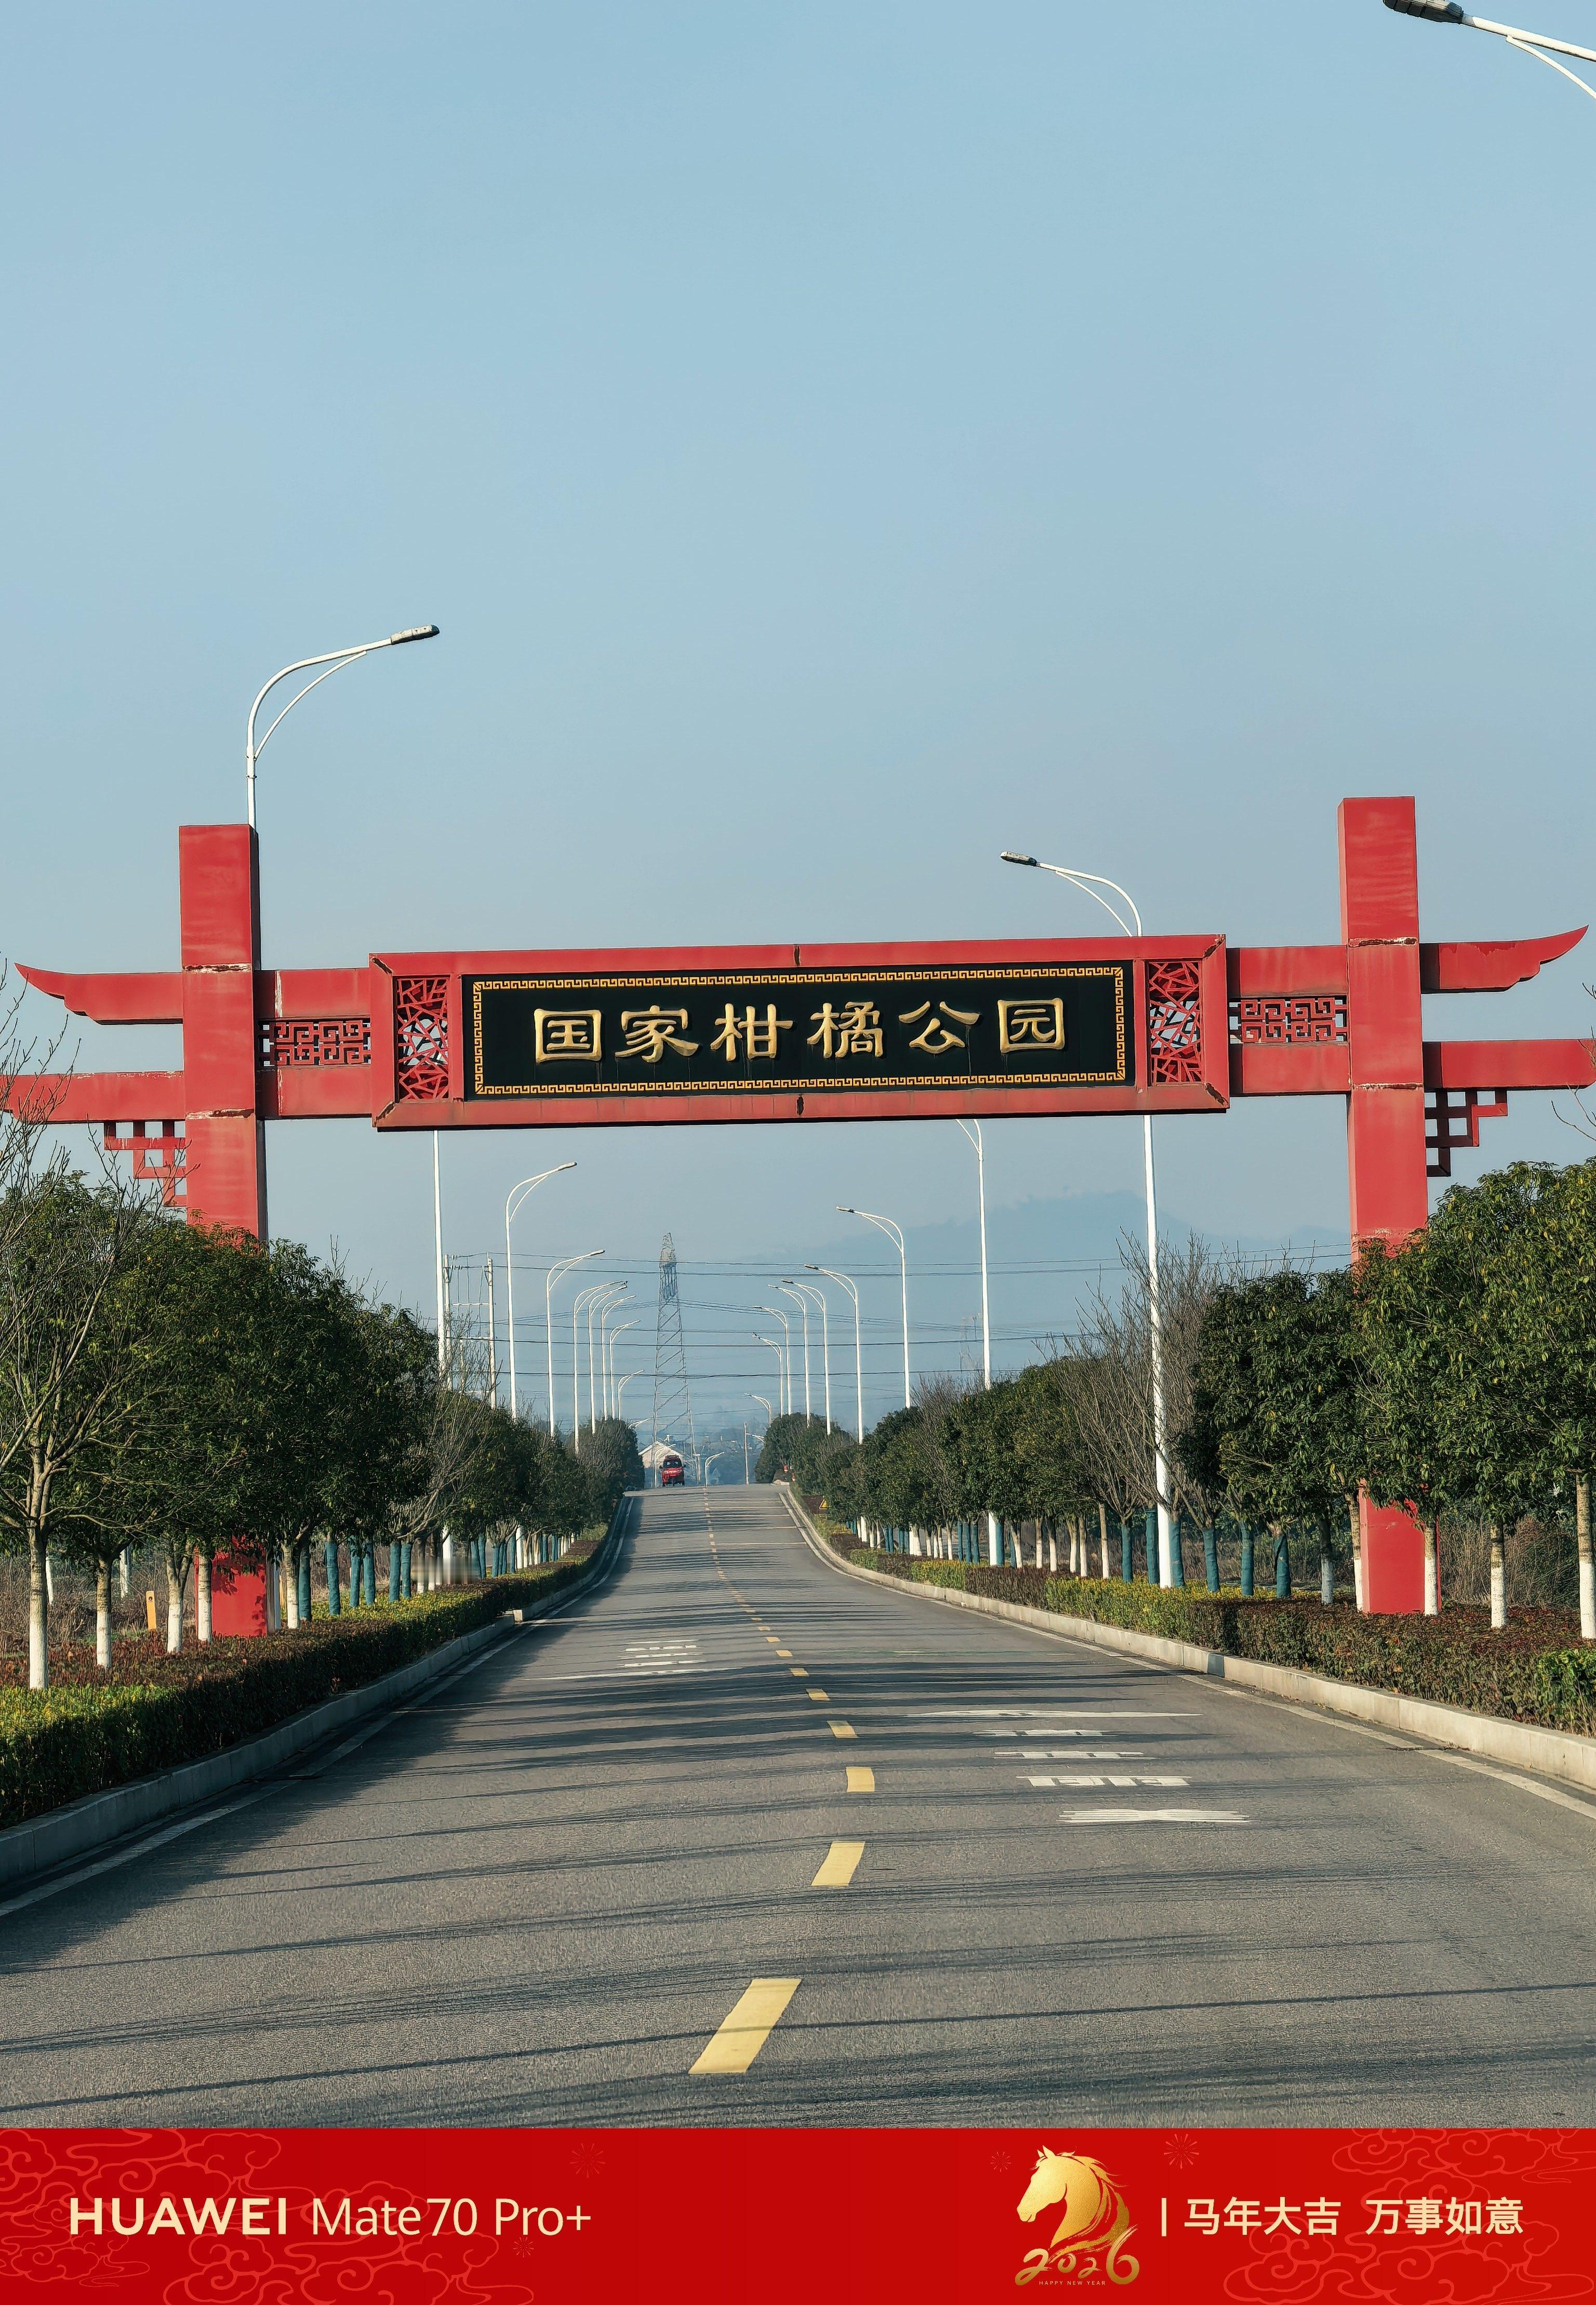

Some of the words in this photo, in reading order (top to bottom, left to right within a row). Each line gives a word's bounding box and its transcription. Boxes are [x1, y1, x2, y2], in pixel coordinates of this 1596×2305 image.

[534, 999, 1066, 1063] 国家柑橘公园
